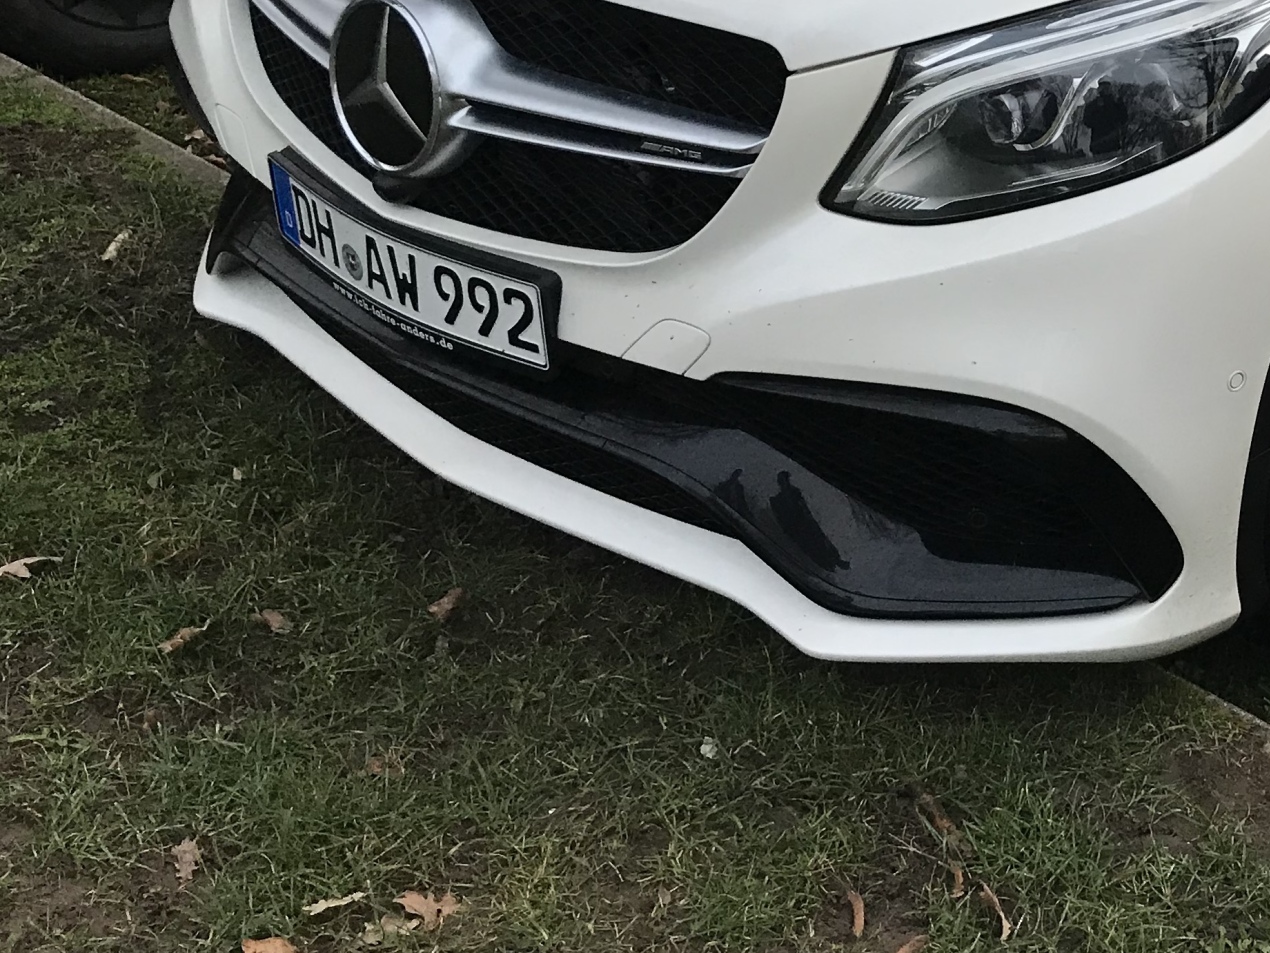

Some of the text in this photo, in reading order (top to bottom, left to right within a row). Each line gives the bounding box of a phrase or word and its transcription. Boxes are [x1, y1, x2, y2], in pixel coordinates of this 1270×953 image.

[660, 144, 702, 161] AMG
[291, 183, 541, 354] DH AW 992
[332, 281, 455, 352] www.ich-fahre-anders.de
